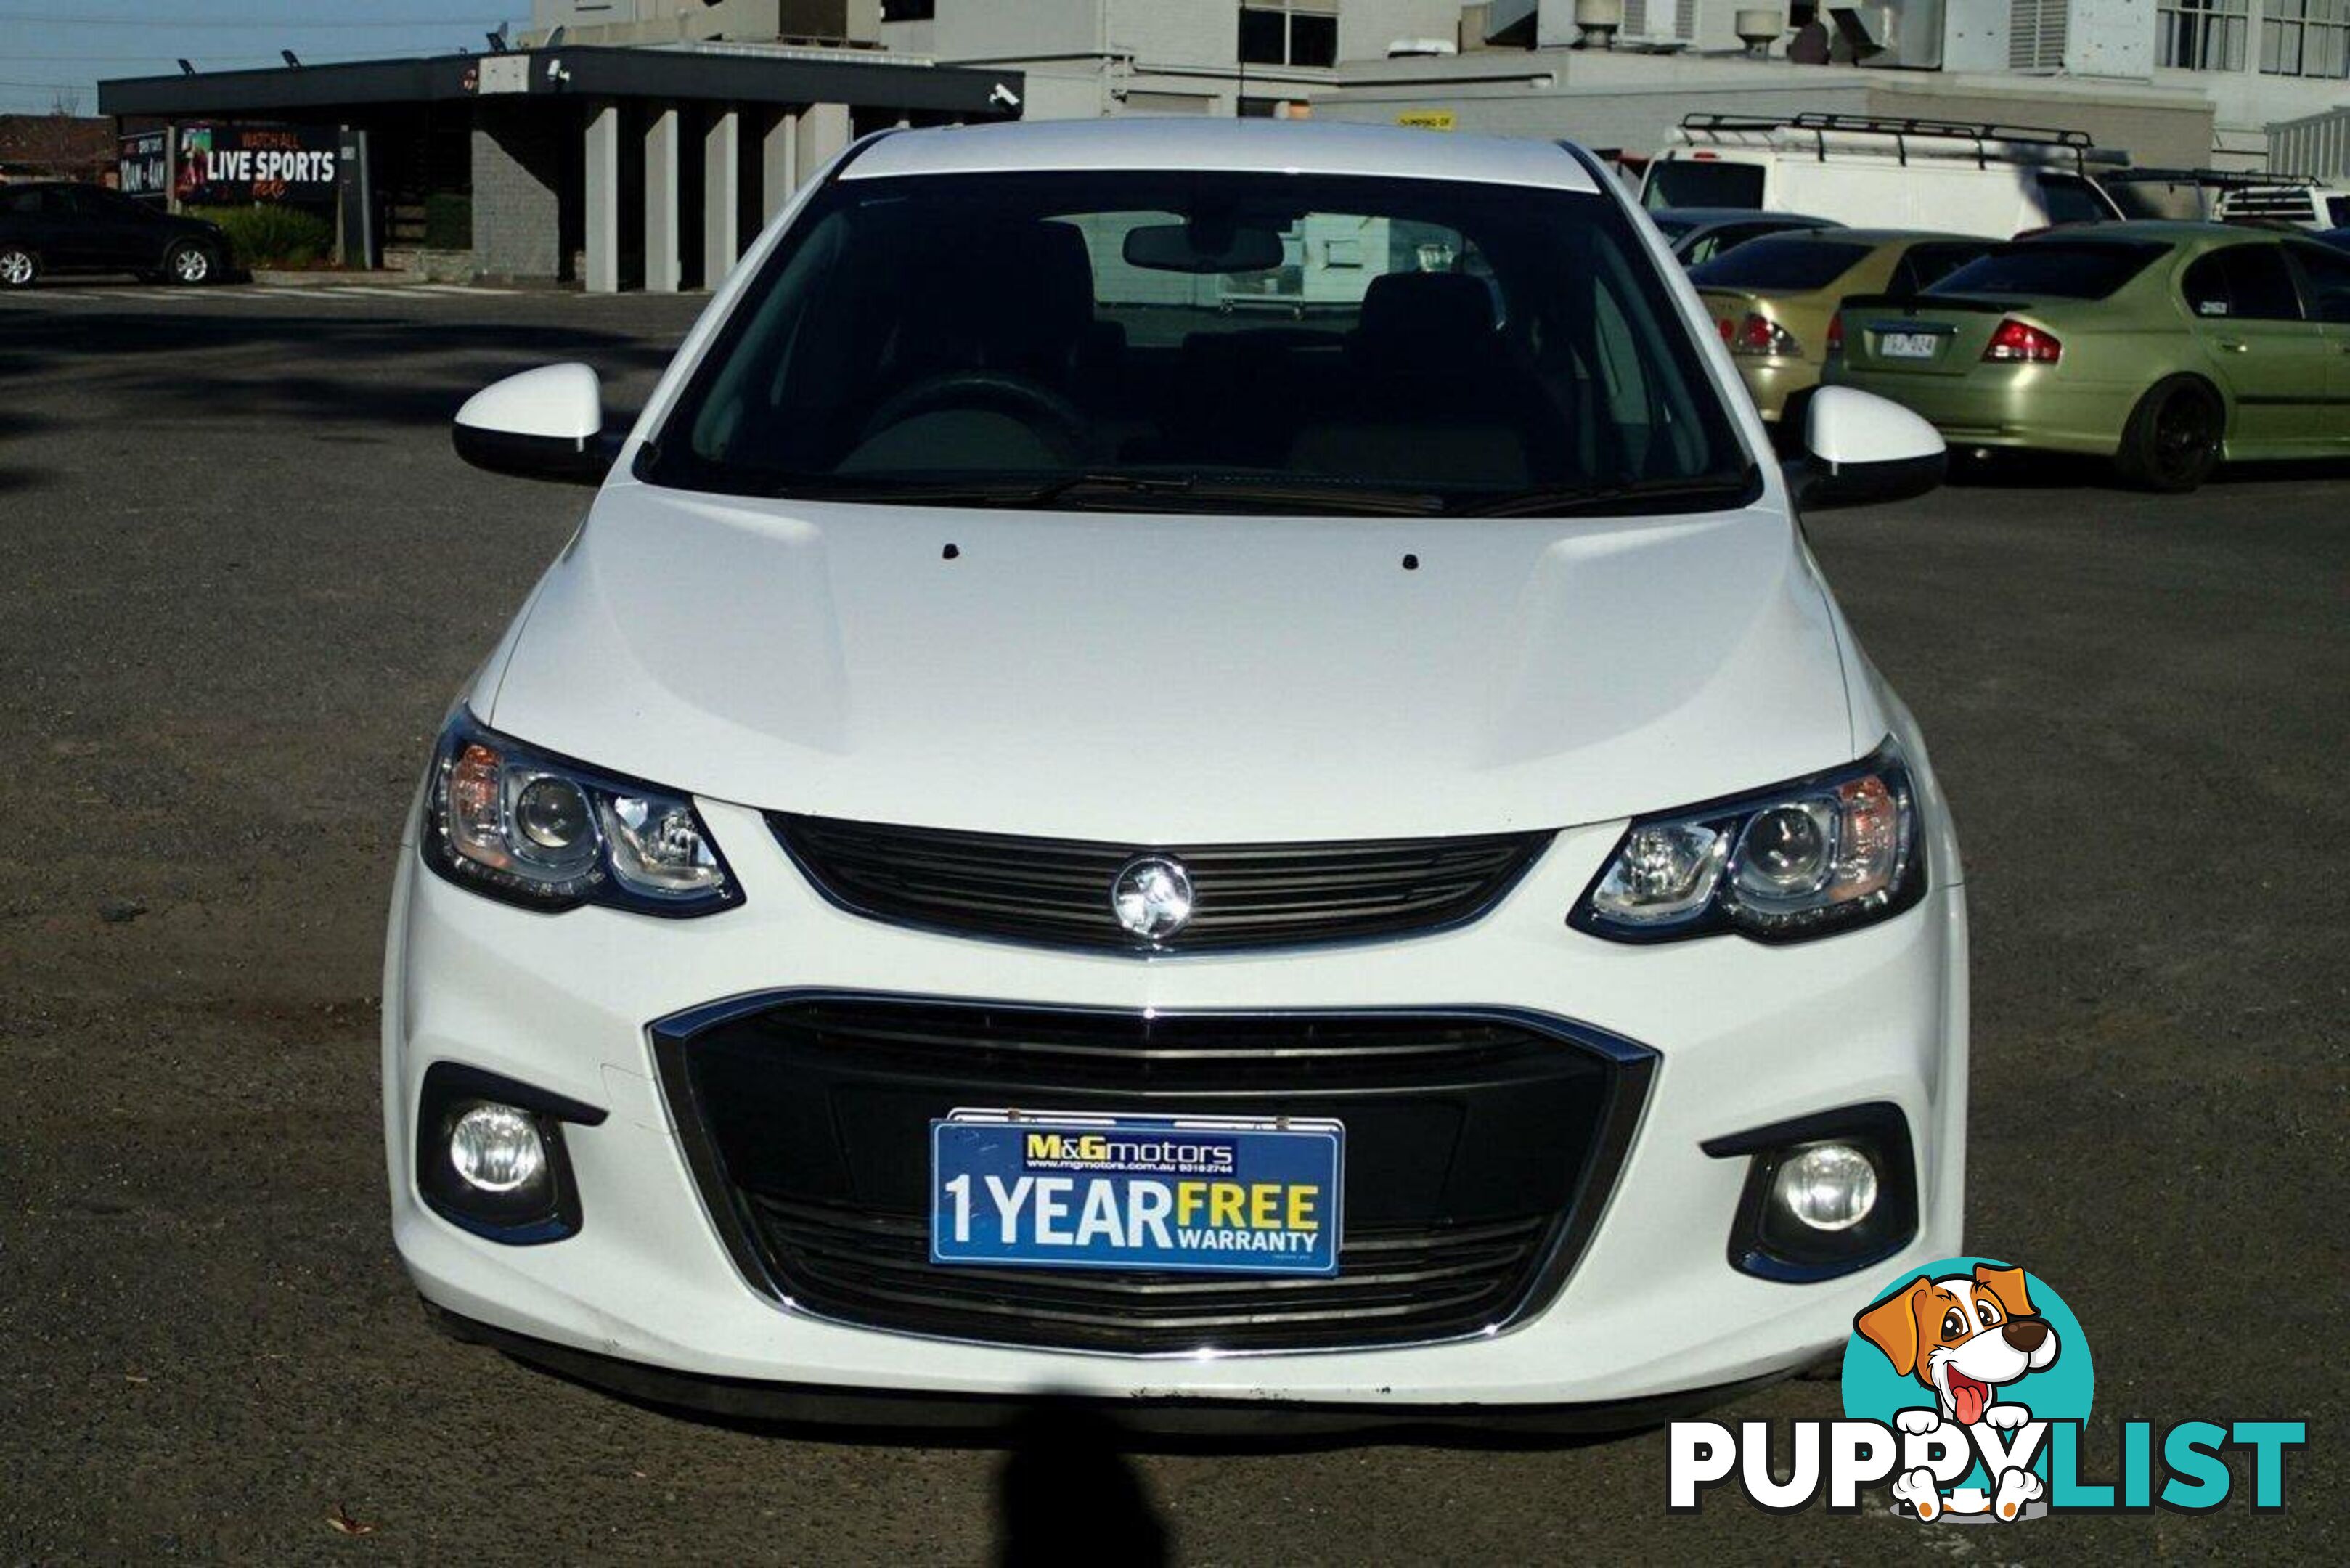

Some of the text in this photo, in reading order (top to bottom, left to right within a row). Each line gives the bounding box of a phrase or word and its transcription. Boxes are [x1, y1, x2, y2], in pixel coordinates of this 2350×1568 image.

[208, 151, 251, 181] LIVE
[256, 151, 335, 181] SPORTS
[1027, 1159, 1175, 1171] www.mgmotors.com.au
[945, 1173, 1318, 1249] 1 YEAR FREE
[1178, 1228, 1318, 1253] WARRANTY
